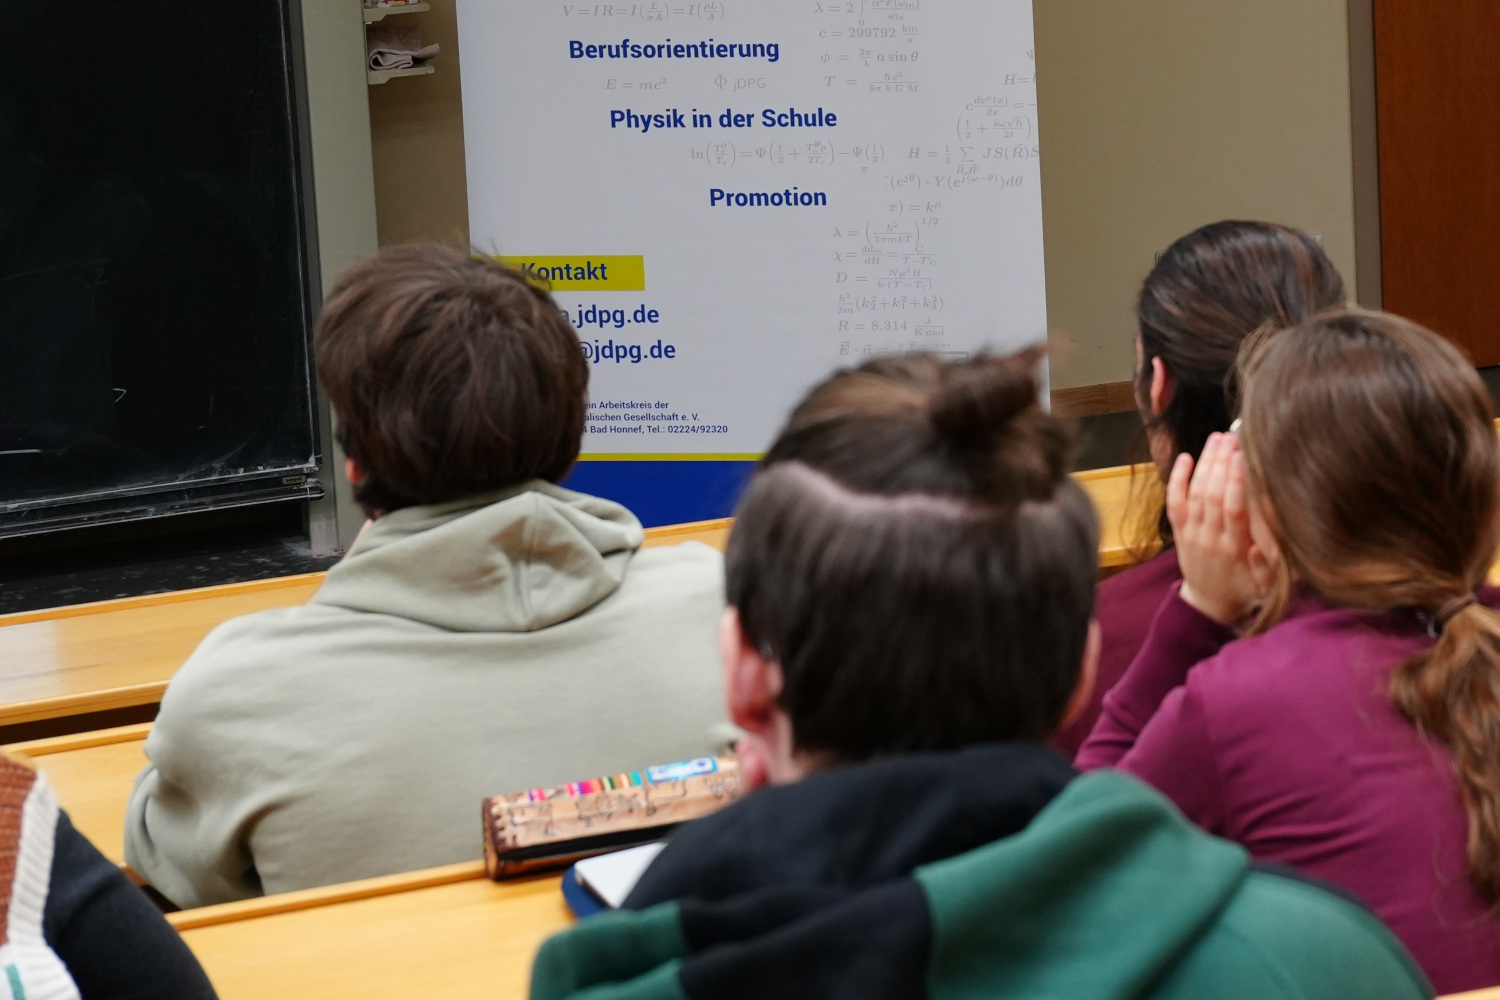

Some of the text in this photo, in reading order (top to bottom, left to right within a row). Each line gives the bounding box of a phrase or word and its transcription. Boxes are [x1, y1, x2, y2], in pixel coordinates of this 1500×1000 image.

[848, 28, 896, 38] 299792
[570, 39, 779, 62] Berufsorientierung
[733, 78, 765, 92] jDPG
[611, 108, 836, 132] Physik in der Schule
[710, 187, 826, 206] Promotion
[522, 261, 608, 280] Kontakt
[624, 413, 678, 421] Gesellschaft
[590, 425, 607, 433] Bad
[610, 425, 644, 434] Honnef,
[648, 425, 665, 433] Tel.:
[668, 425, 728, 434] 02224/92320
